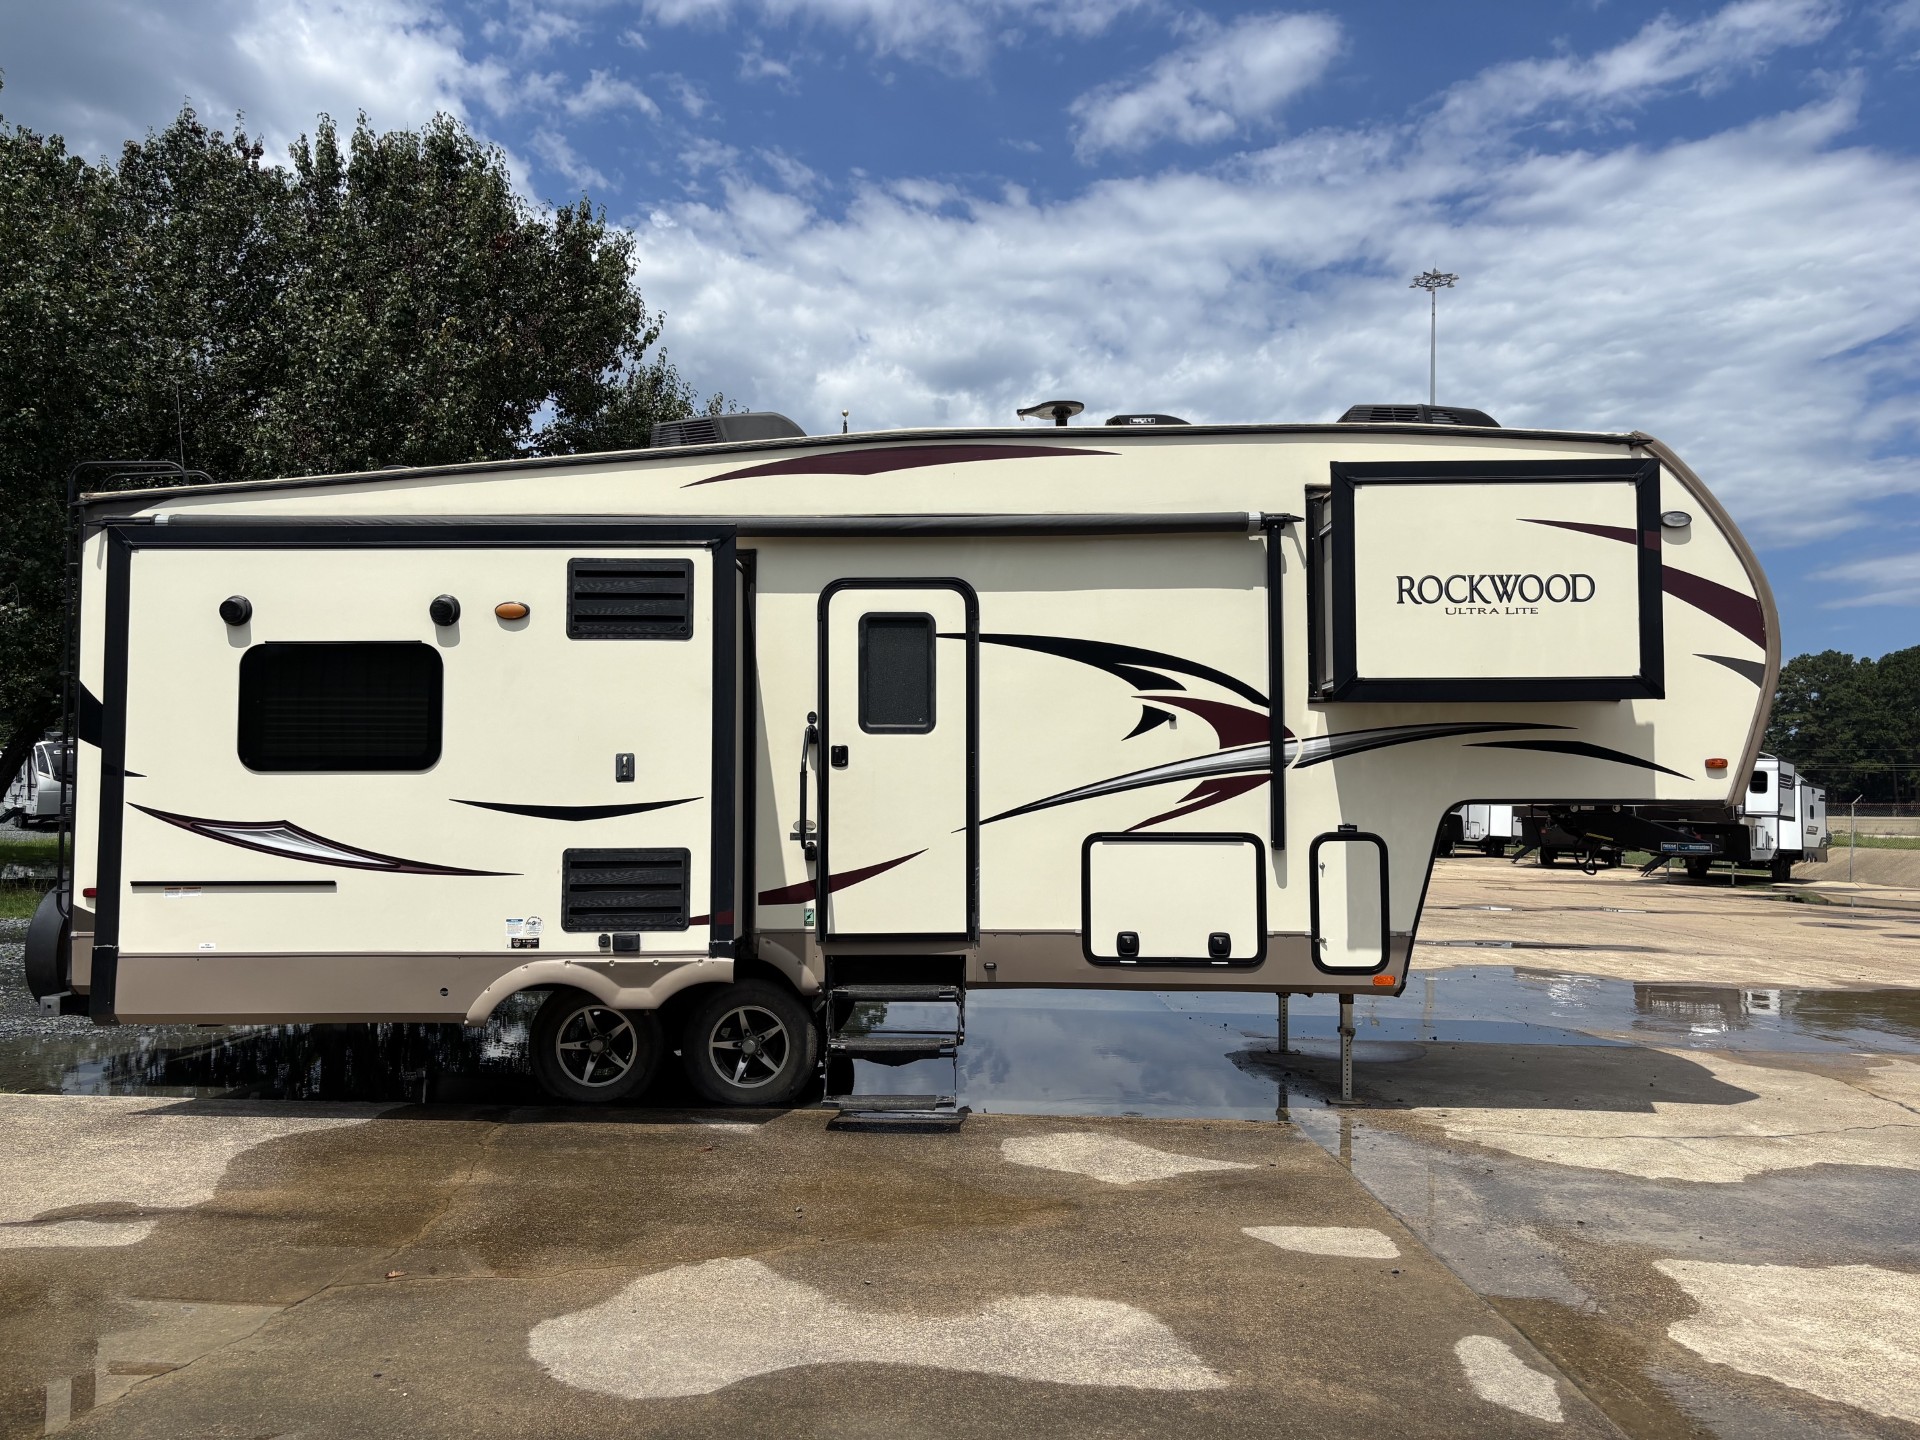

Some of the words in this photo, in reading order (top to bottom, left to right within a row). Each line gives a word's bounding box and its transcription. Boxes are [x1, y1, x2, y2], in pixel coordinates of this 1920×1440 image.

[1396, 573, 1596, 605] ROCKWOOD
[1444, 607, 1500, 616] ULTRA
[1505, 607, 1539, 615] LITE
